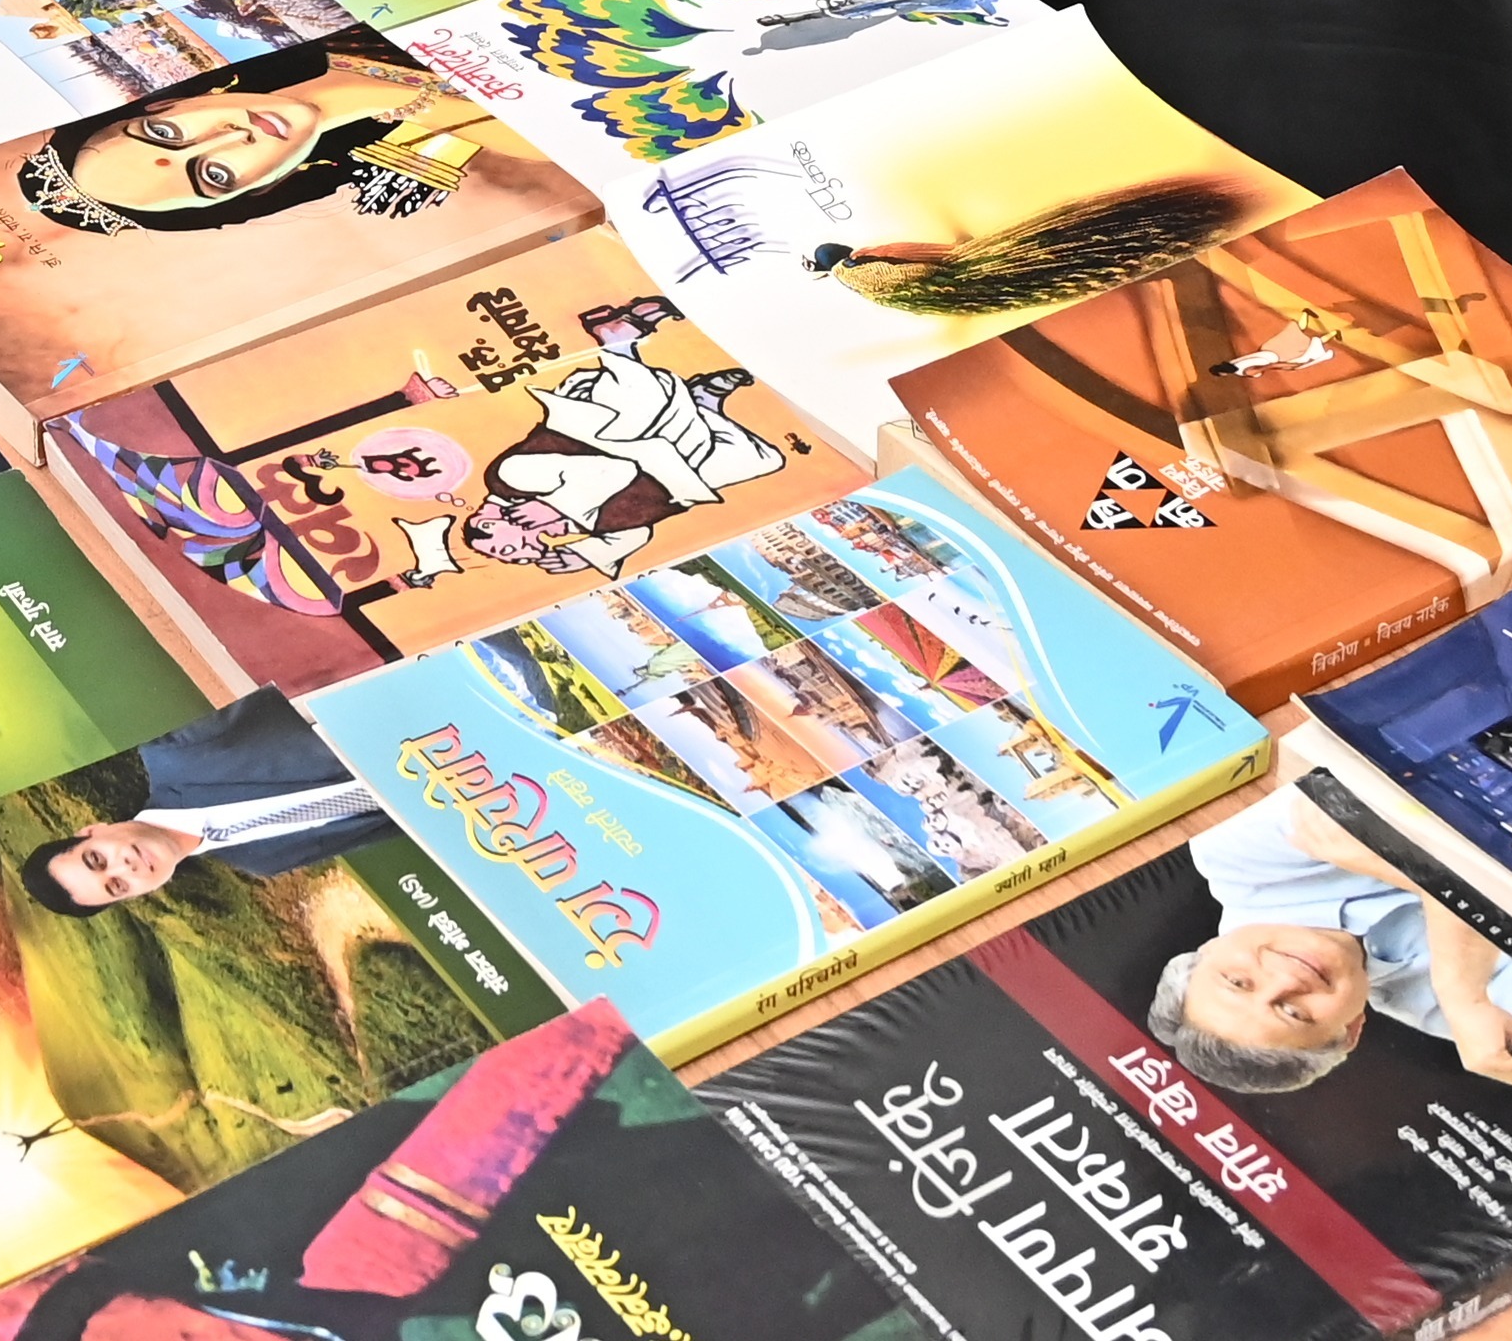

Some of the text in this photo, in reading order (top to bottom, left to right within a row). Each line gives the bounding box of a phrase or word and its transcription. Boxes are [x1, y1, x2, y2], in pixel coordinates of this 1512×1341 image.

[467, 288, 560, 370] देशपांडे
[1159, 462, 1210, 500] विजय
[1182, 452, 1233, 495] नाईक
[32, 621, 67, 652] साने
[1312, 593, 1450, 675] त्रिकोण विजय नाईक
[399, 727, 661, 968] रंग पश्चिमेचे
[546, 768, 643, 857] ज्योती म्हात्रे
[398, 873, 439, 909] (IAS)
[754, 845, 1069, 1017] रंग पश्चिमेचे ज्योती म्हात्रे
[464, 950, 509, 995] संकेत
[725, 1106, 805, 1188] YOU CAN WIN
[853, 1059, 1013, 1219] जिंकू
[1193, 1122, 1289, 1204] शीव
[988, 1096, 1189, 1273] शकता
